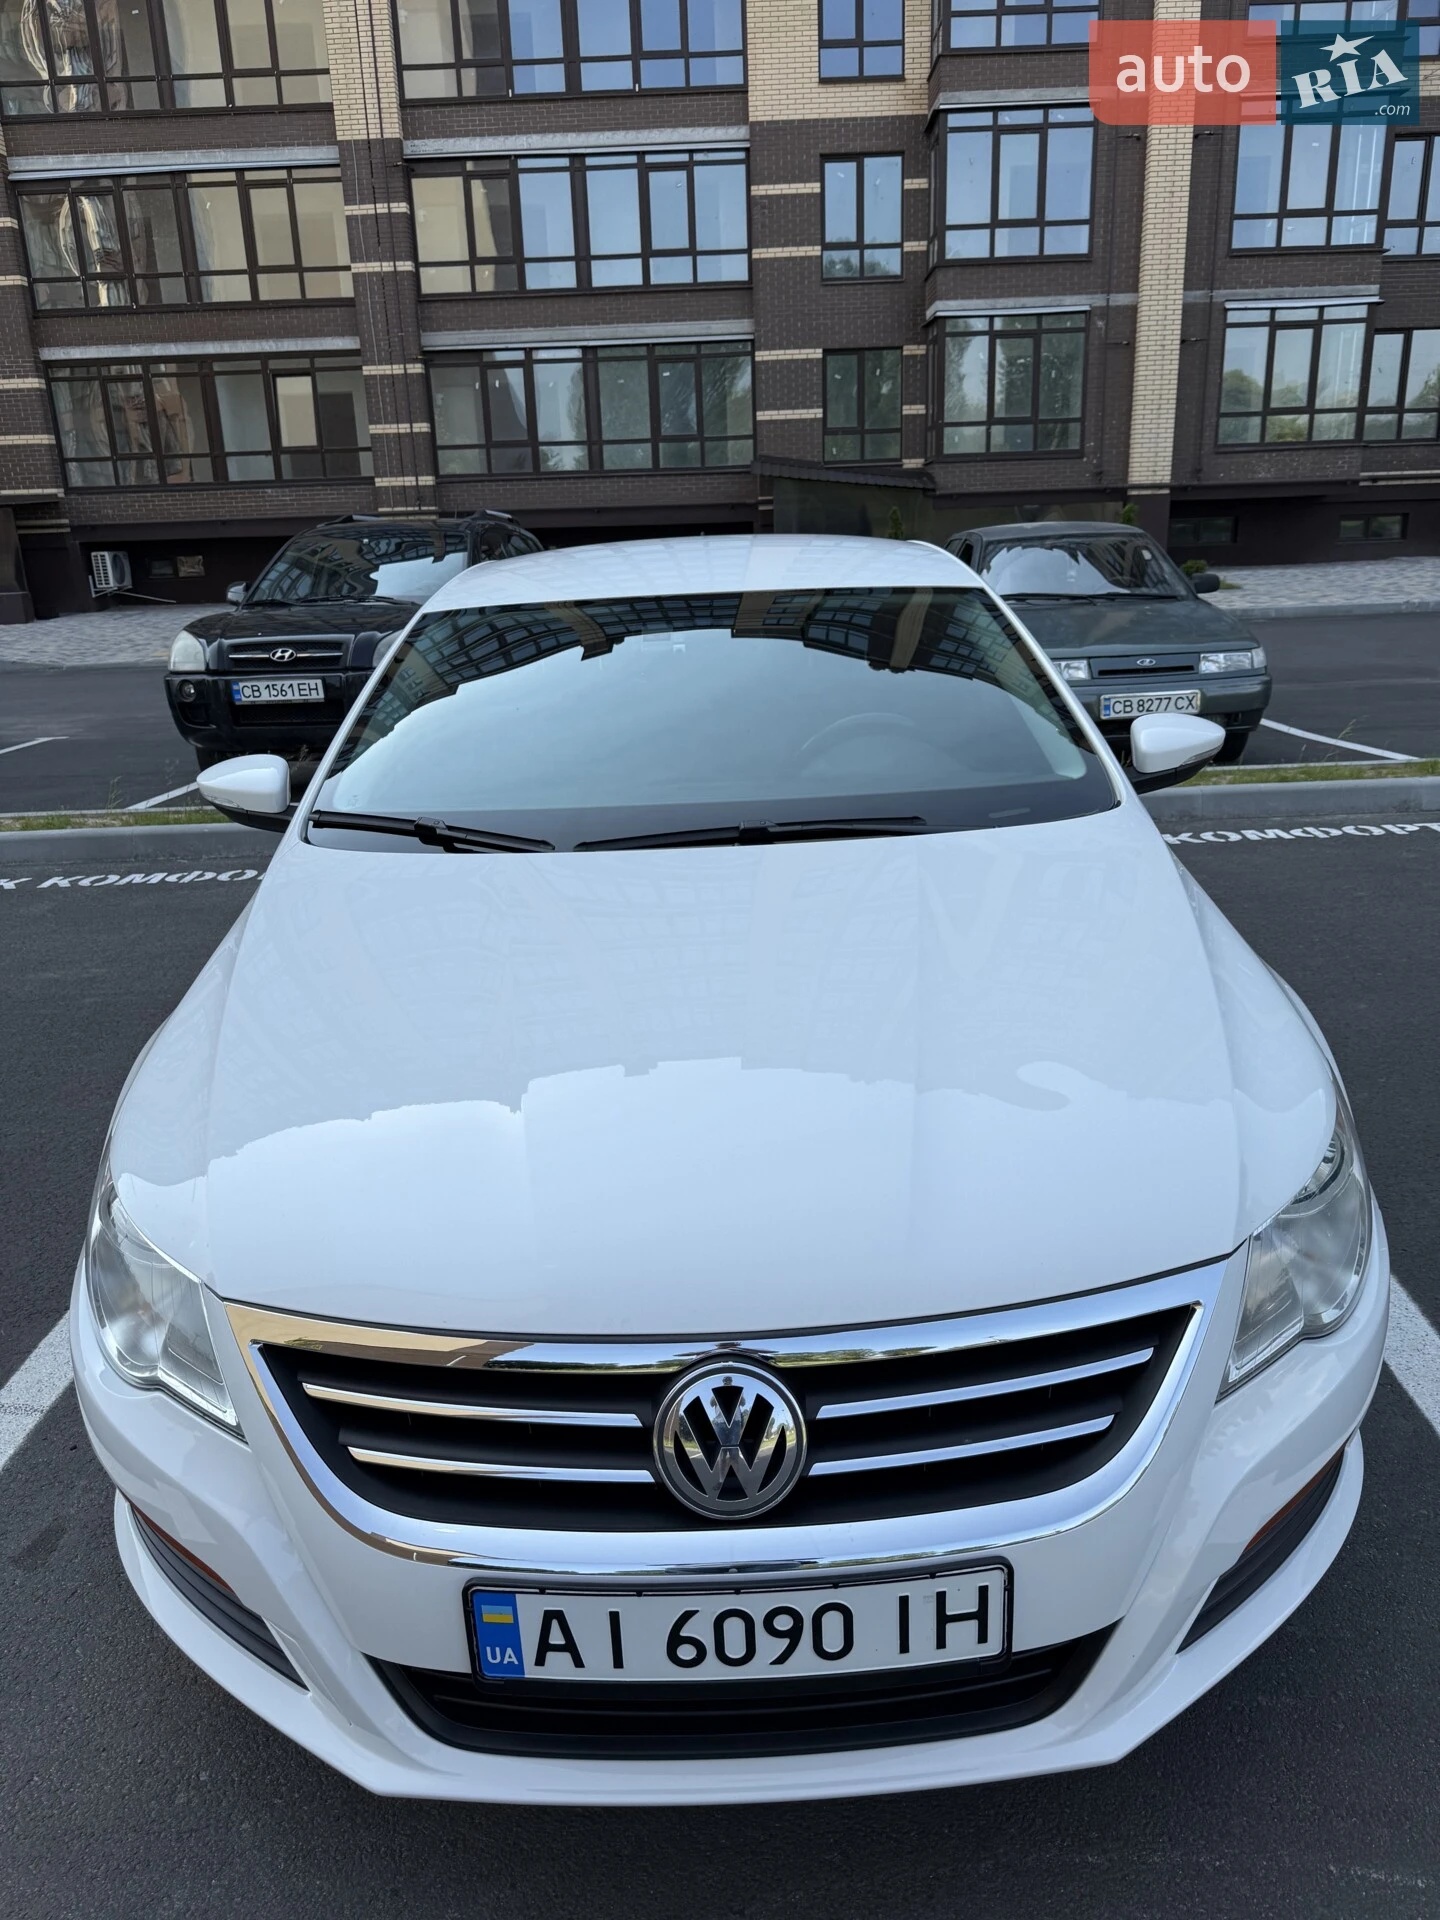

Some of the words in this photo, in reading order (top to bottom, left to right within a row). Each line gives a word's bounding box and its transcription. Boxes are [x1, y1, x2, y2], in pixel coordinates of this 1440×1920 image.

[241, 684, 262, 699] CB
[264, 683, 296, 698] 1561
[297, 682, 320, 697] EH
[1111, 699, 1134, 715] CB
[1136, 697, 1172, 713] 8277
[1174, 695, 1196, 711] CX
[36, 869, 268, 889] КОМФО
[666, 1601, 854, 1669] 6090
[899, 1585, 989, 1654] IH
[486, 1645, 519, 1665] UA
